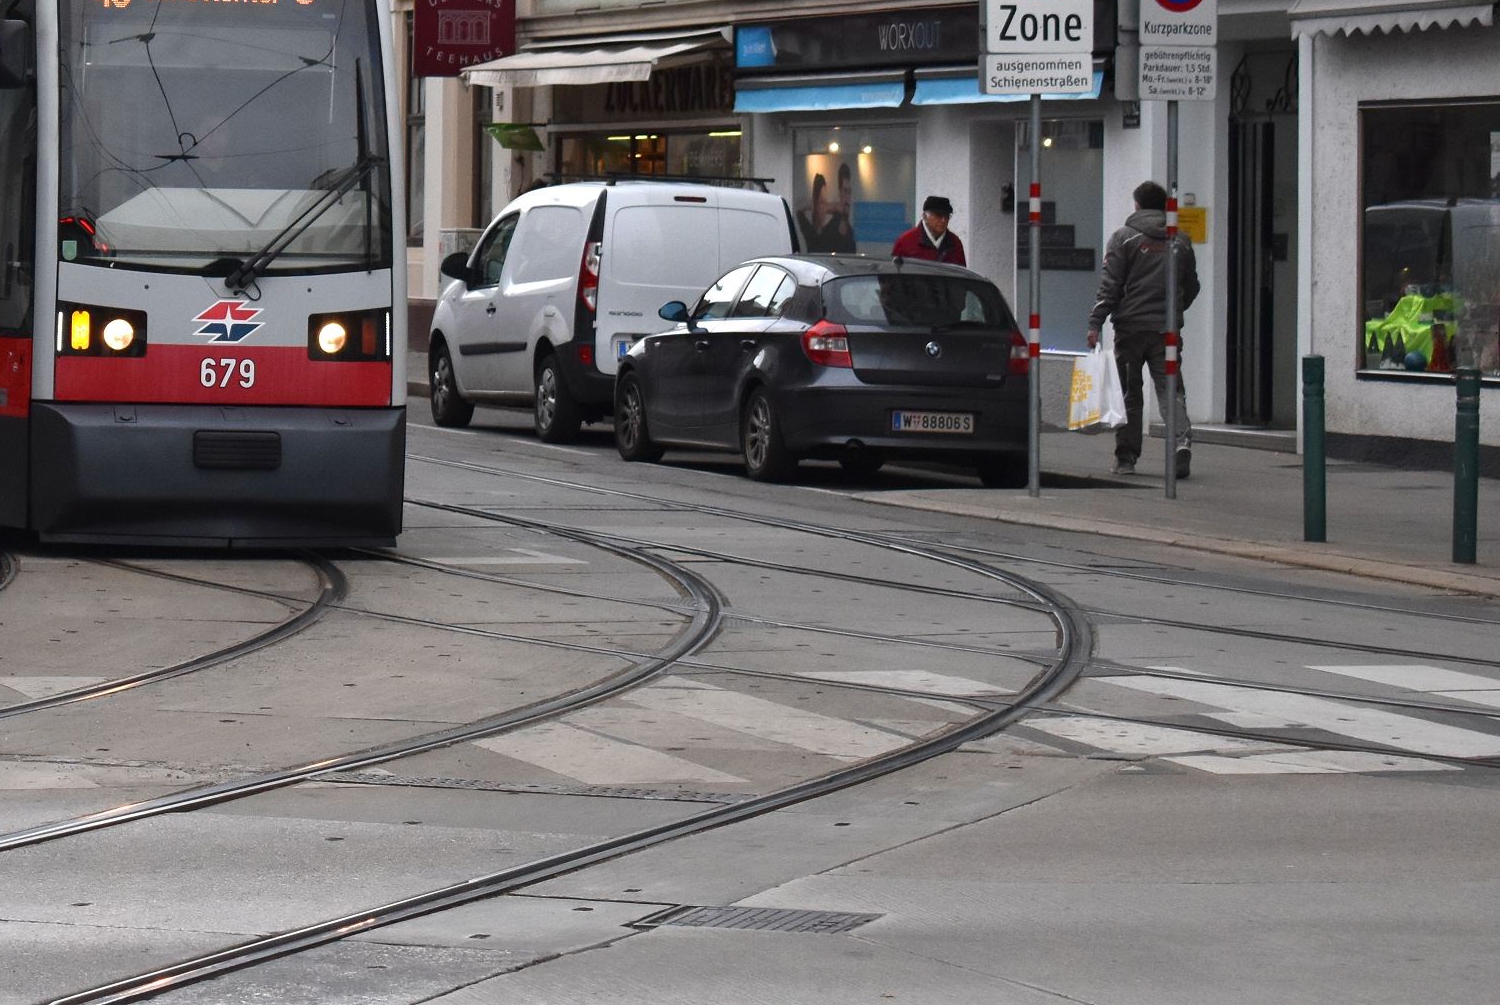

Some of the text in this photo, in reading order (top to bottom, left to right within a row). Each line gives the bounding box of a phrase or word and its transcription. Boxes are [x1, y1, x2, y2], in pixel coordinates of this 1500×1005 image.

[999, 4, 1082, 41] Zone
[1144, 21, 1212, 36] Kurzparkzone
[878, 21, 940, 51] WORXOUT
[426, 46, 503, 65] TEEHAUS
[996, 59, 1082, 73] ausgenommen
[991, 75, 1088, 88] Schienenstraßen
[201, 357, 255, 389] 679
